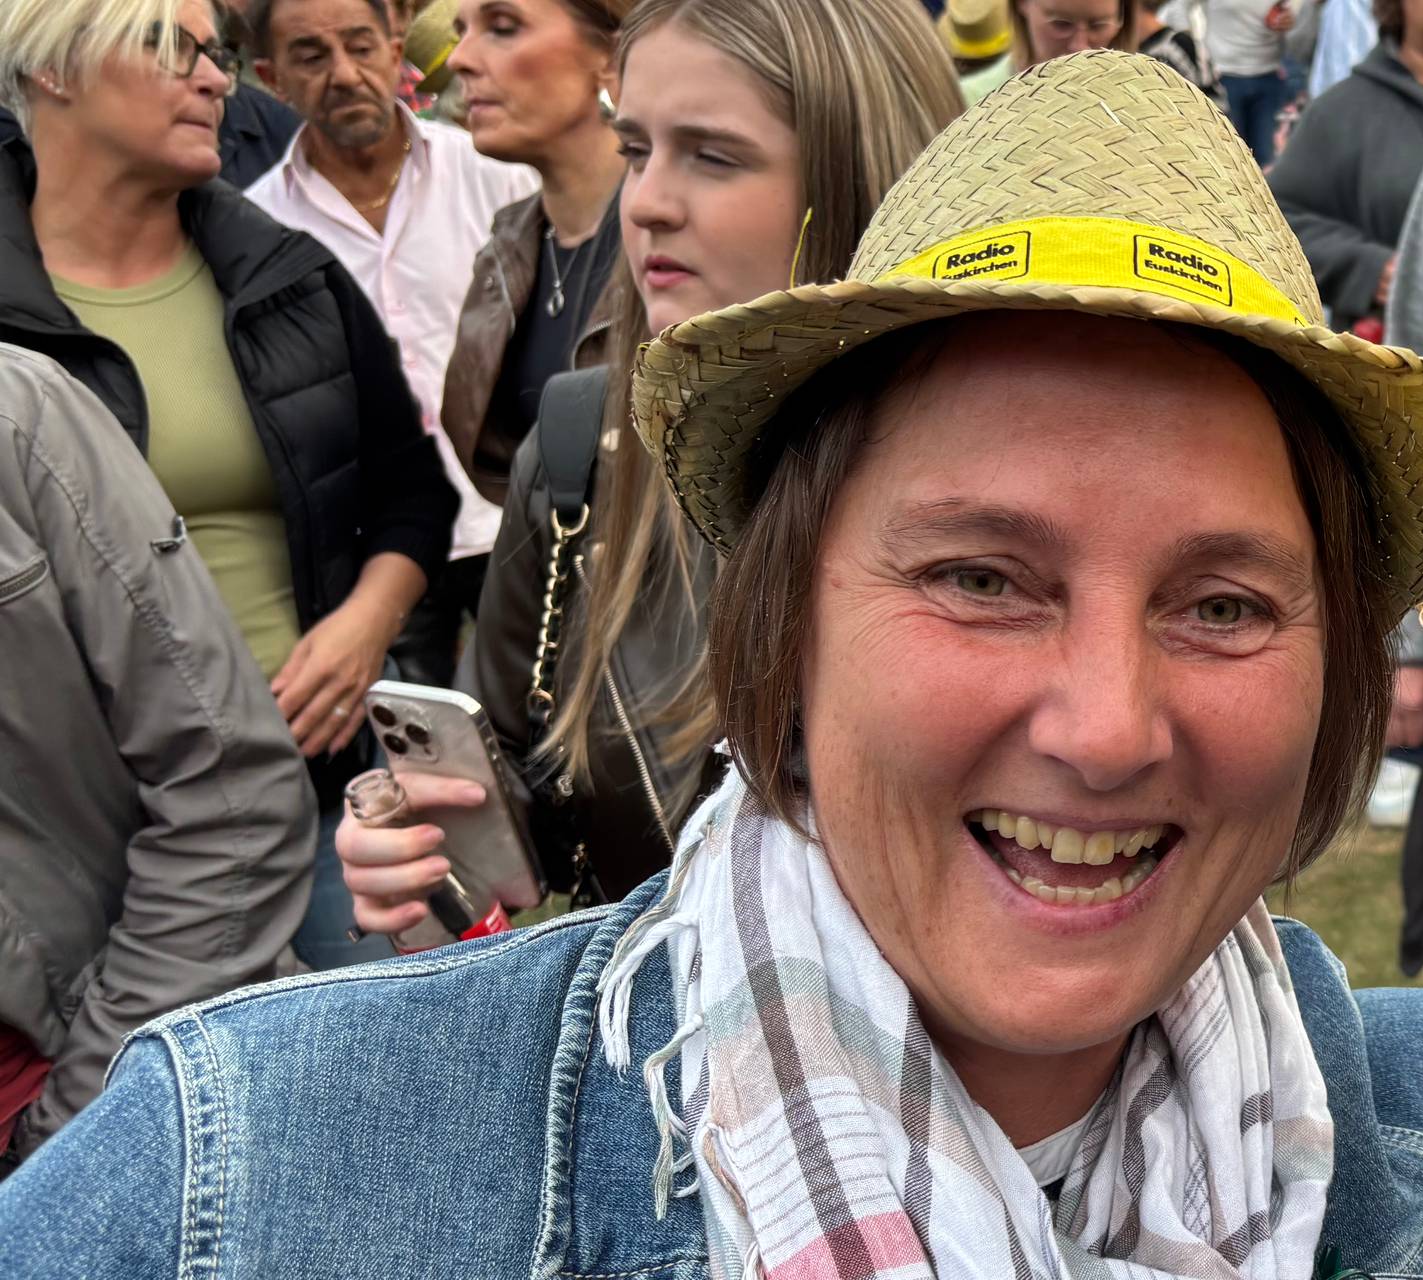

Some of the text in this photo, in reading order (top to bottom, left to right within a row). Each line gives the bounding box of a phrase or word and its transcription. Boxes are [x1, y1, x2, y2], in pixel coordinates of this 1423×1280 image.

[946, 243, 1015, 270] Radio
[1149, 243, 1218, 277] Radio
[1145, 259, 1223, 292] Euskirchen
